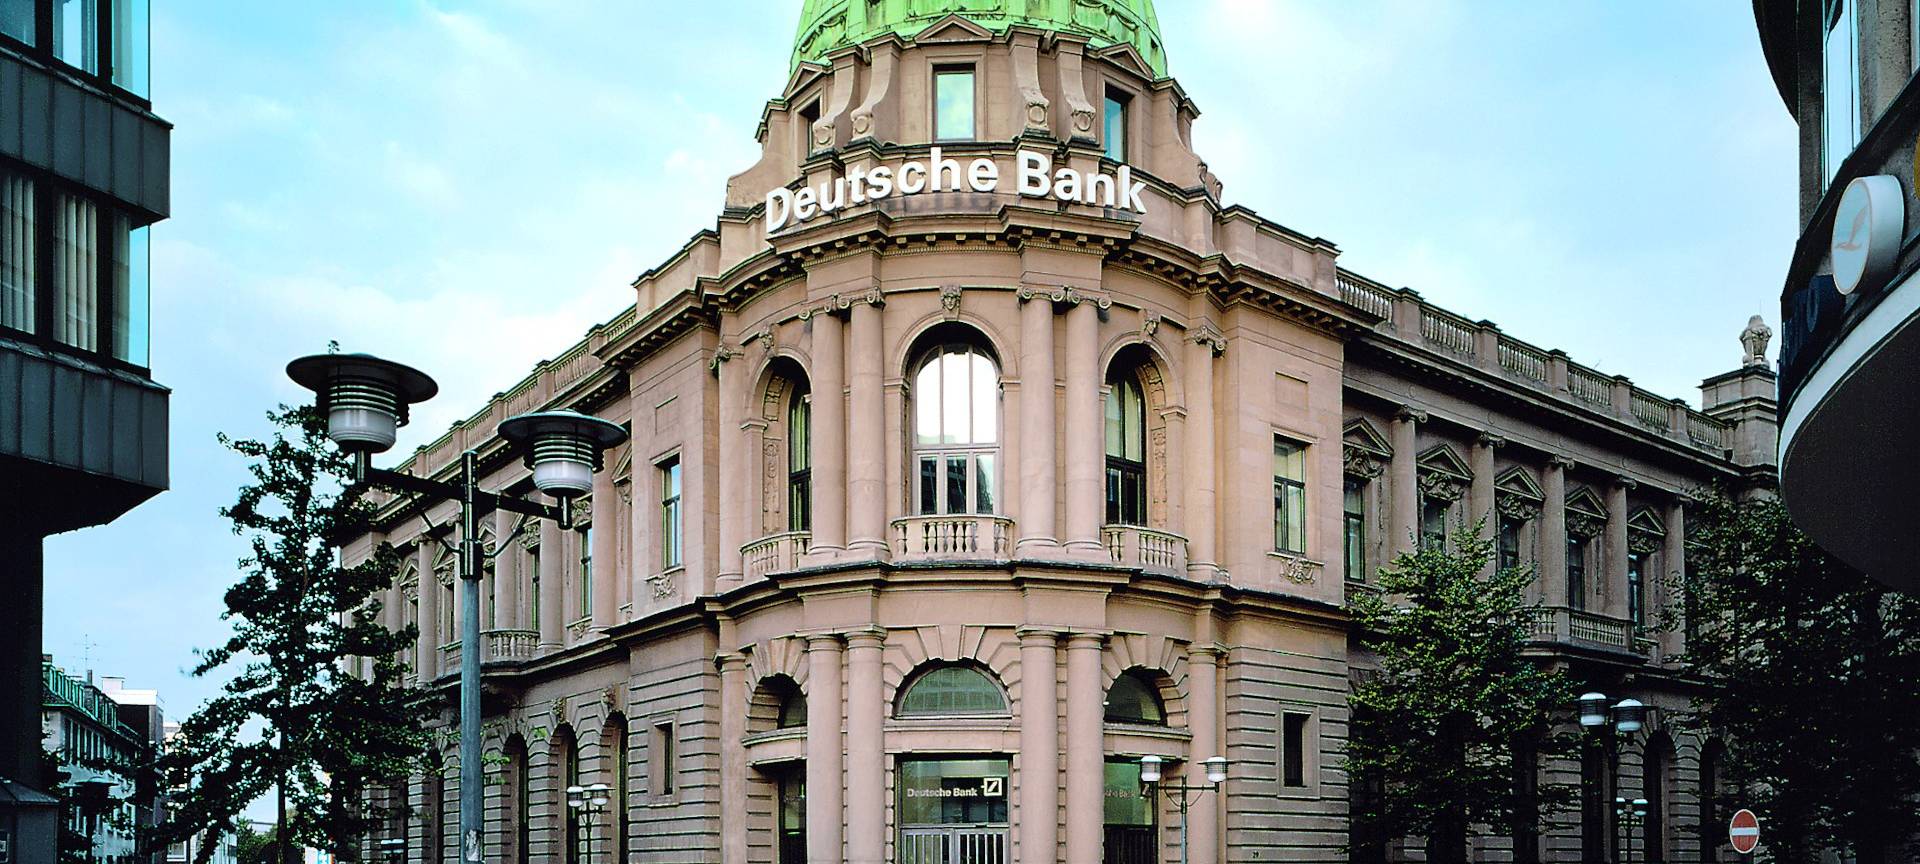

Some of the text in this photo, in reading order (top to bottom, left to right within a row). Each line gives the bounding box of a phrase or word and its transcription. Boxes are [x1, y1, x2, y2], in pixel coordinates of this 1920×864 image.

[766, 147, 1148, 233] Deutsche Bank
[907, 788, 978, 797] Deutsche Bank
